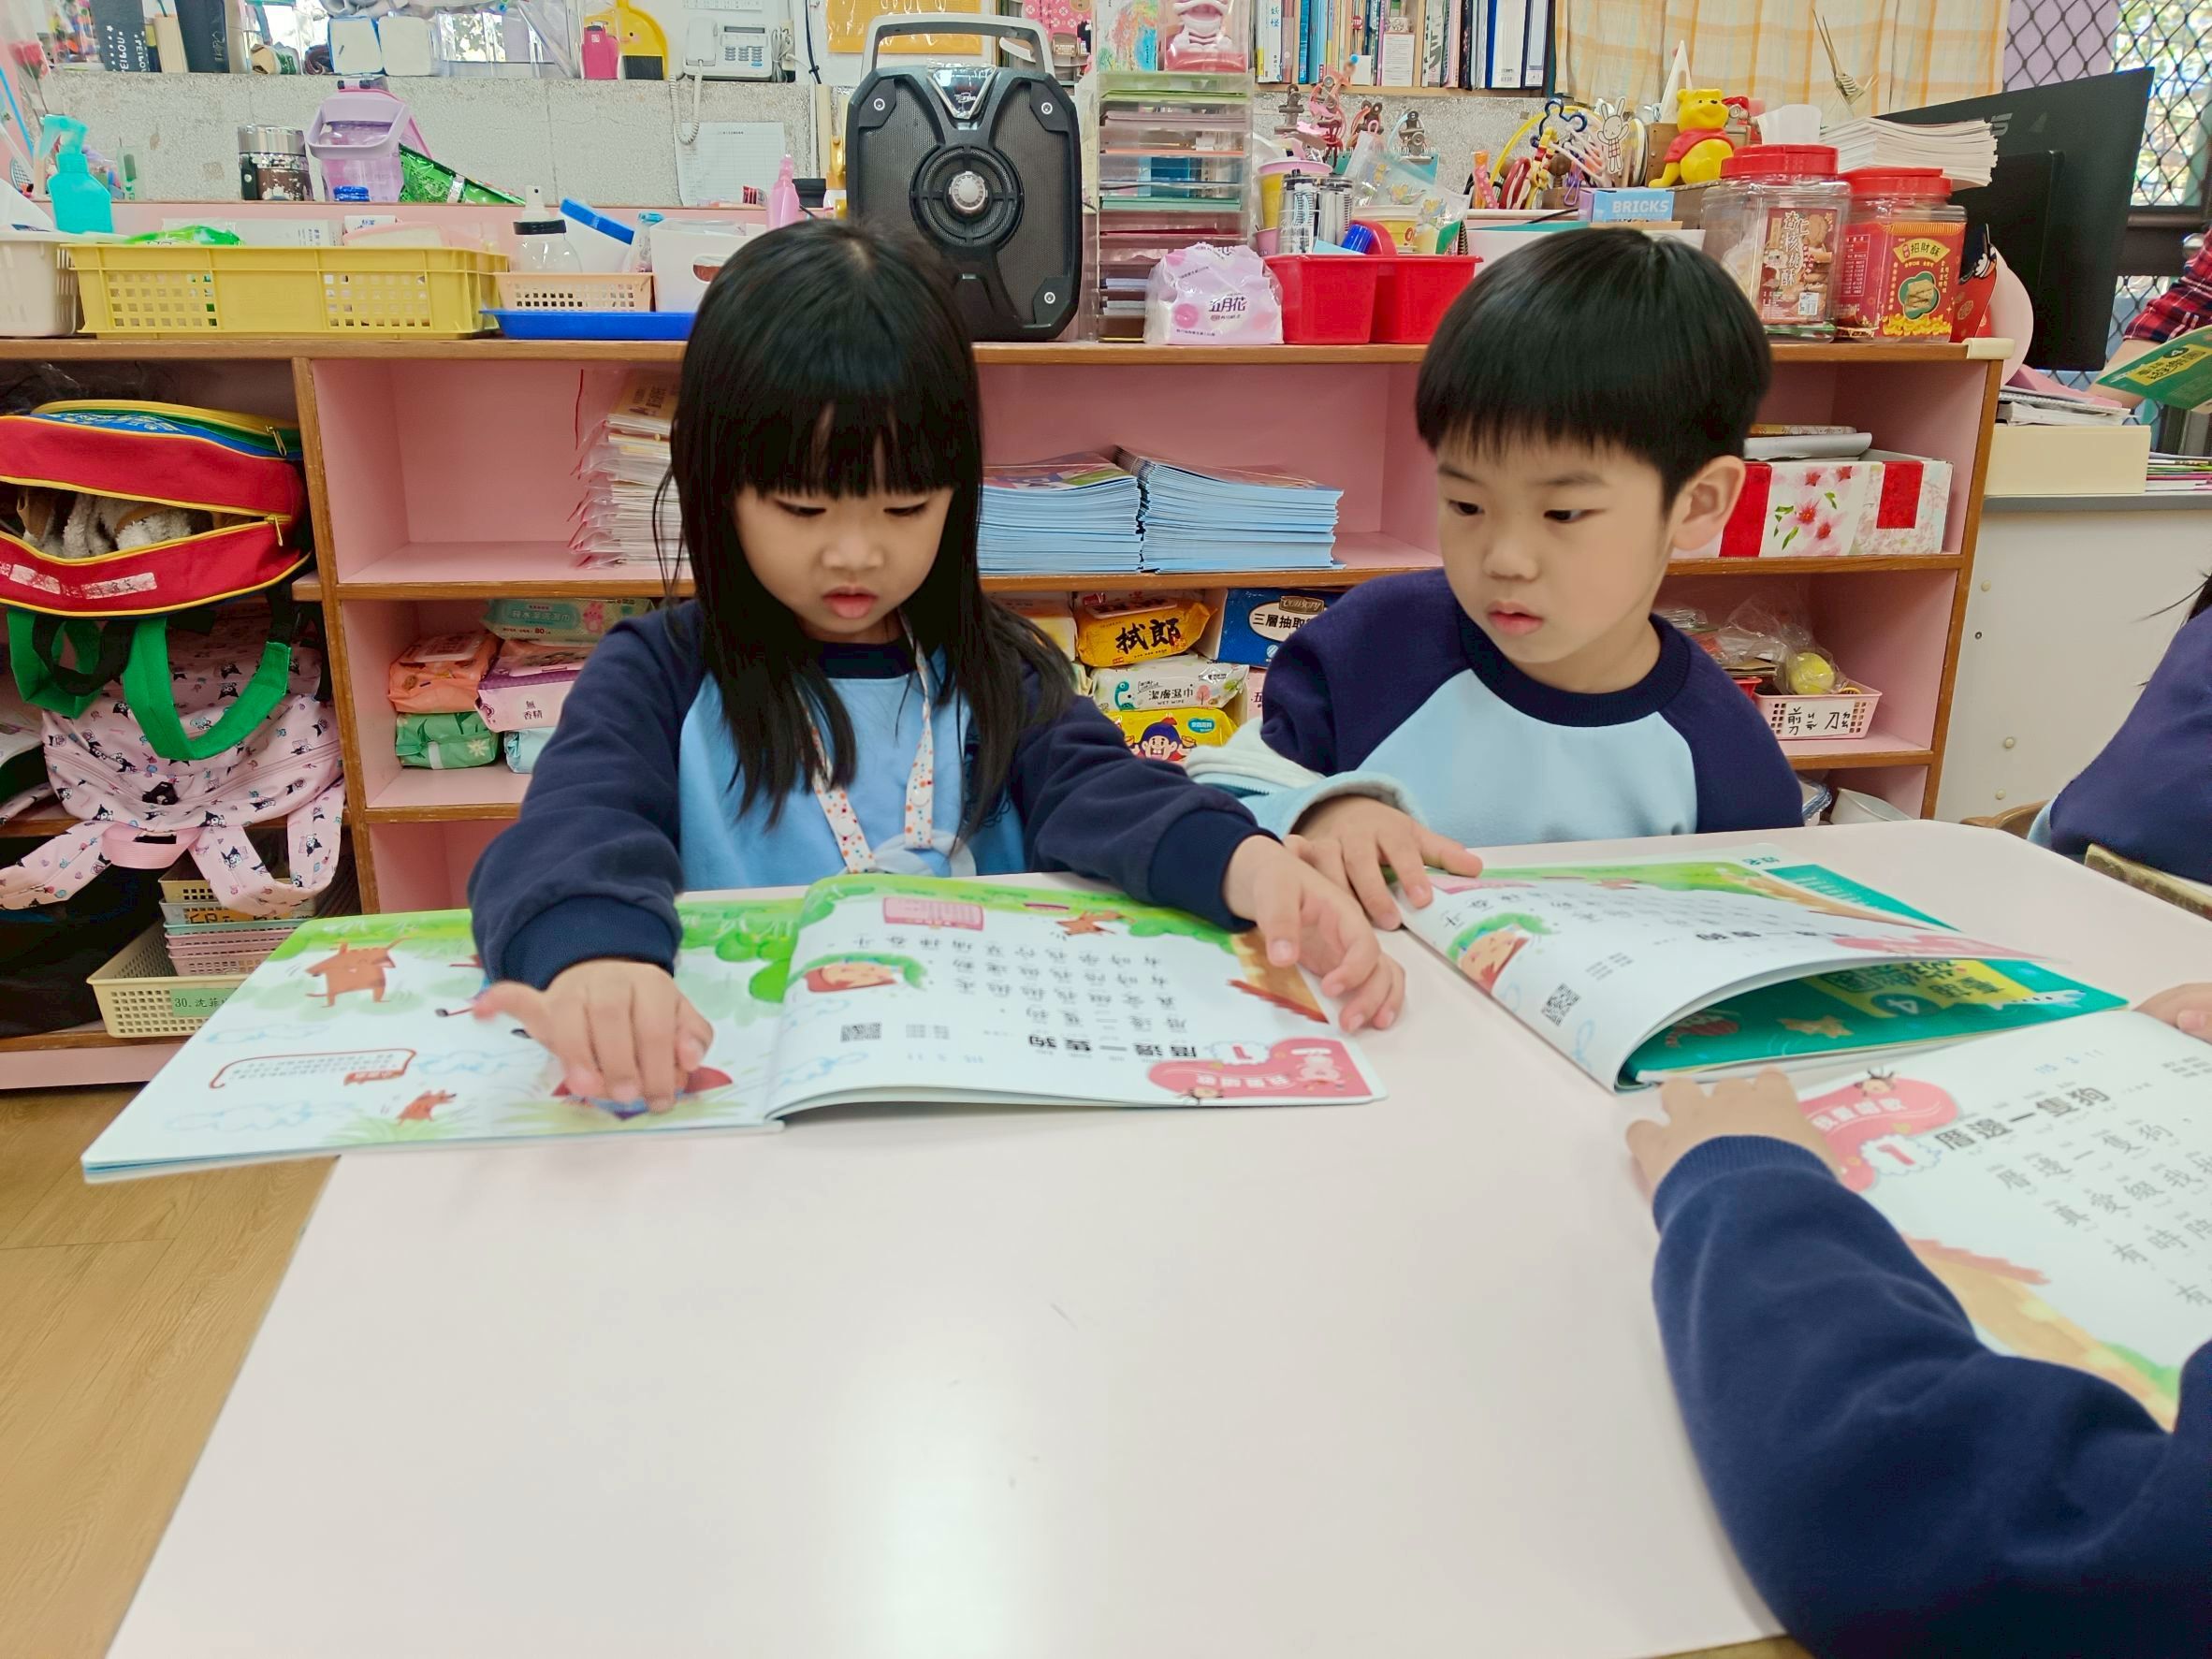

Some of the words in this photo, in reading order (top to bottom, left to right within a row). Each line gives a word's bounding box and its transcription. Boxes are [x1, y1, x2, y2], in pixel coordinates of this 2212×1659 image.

[1612, 200, 1669, 213] BRICKS
[1911, 241, 1941, 257] 招財酥
[1208, 296, 1247, 313] 五月花
[1253, 613, 1310, 629] 三層抽取
[1115, 618, 1181, 654] 拭郎
[1148, 688, 1193, 700] 潔膚濕巾
[524, 710, 543, 720] 香精
[1935, 1086, 2111, 1151] 厝邊一隻狗
